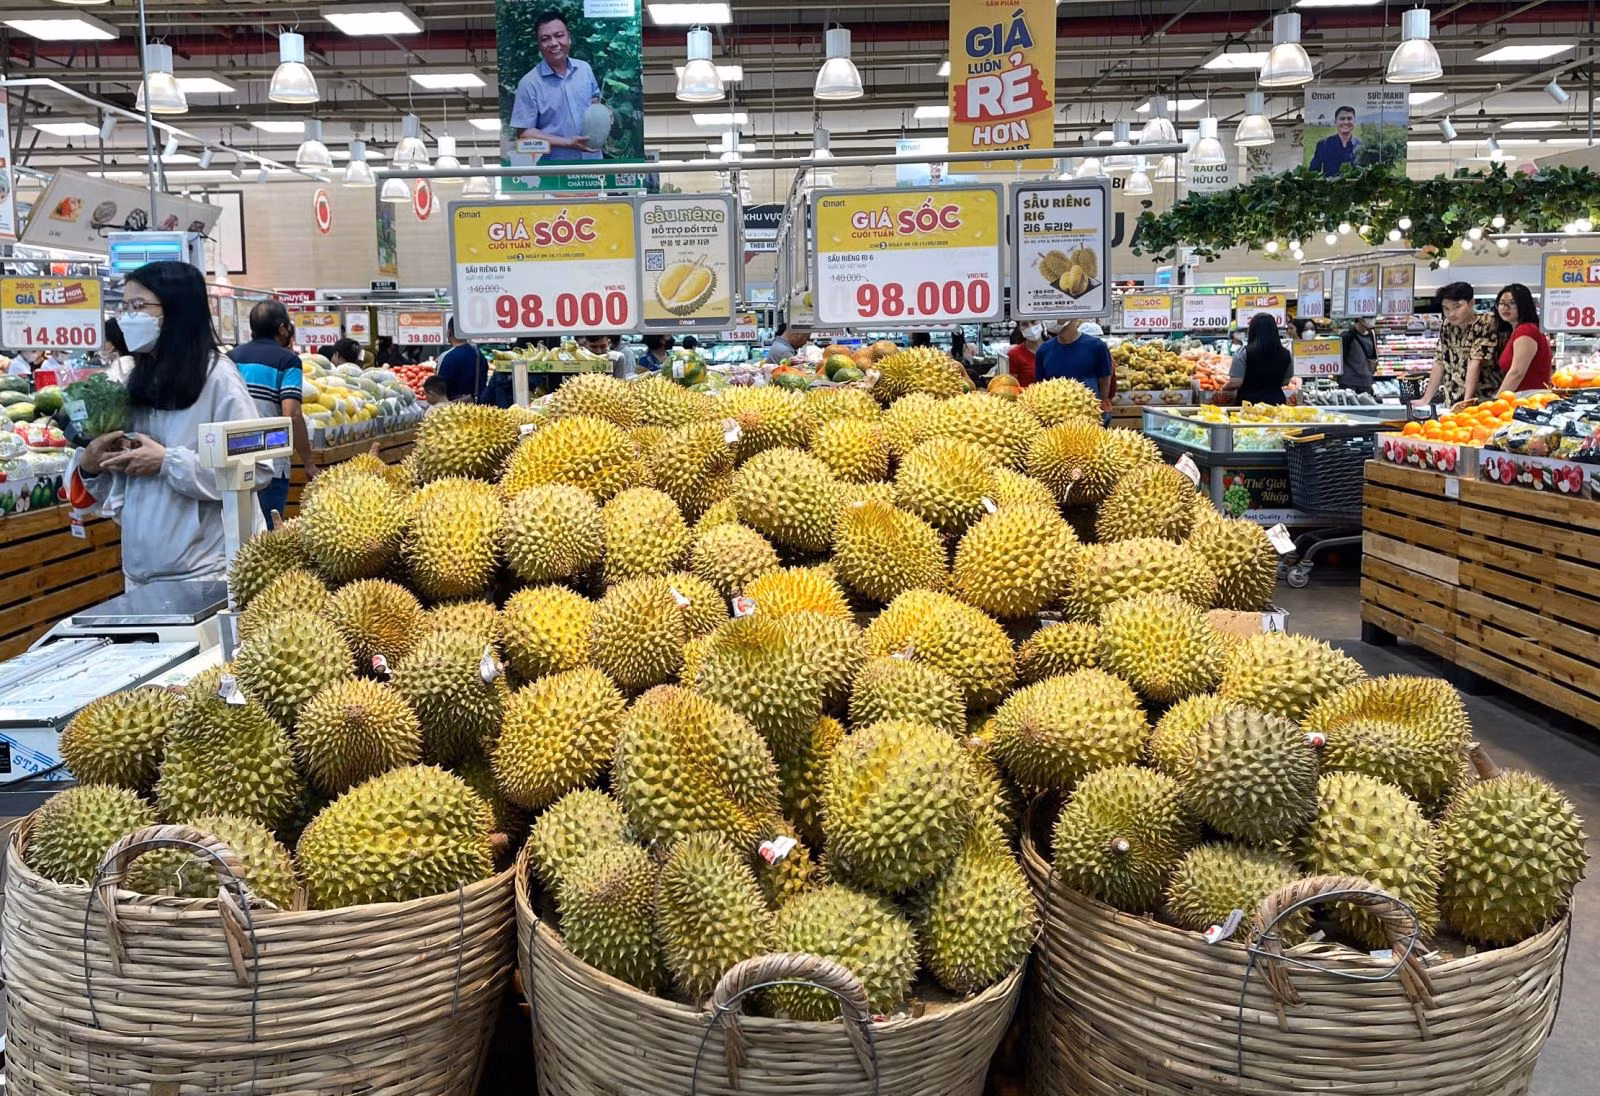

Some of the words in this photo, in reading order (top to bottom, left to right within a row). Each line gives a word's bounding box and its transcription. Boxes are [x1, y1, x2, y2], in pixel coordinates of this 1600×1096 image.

[966, 8, 1033, 58] GIÁ
[968, 59, 1002, 75] LUÔN
[967, 52, 1034, 118] RẺ
[1311, 92, 1335, 100] emart
[972, 119, 1031, 146] HƠN
[823, 200, 846, 208] emart
[1023, 193, 1050, 209] SẦU
[1052, 194, 1091, 208] RIÊNG
[458, 211, 481, 219] emart
[851, 205, 894, 230] GIÁ
[898, 196, 961, 234] SỐC
[488, 217, 532, 241] GIÁ
[534, 208, 597, 247] SỐC
[1044, 222, 1074, 232] 두리안
[869, 254, 874, 262] 6
[507, 265, 512, 273] 6
[1562, 268, 1585, 283] GIÁ
[856, 278, 991, 318] 98.000
[495, 291, 629, 329] 98.000
[1133, 317, 1168, 326] 24.500
[1192, 317, 1228, 326] 25.000
[23, 326, 96, 345] 14.800
[407, 335, 441, 343] 39.800
[728, 331, 756, 339] 15.800
[1310, 363, 1339, 373] 9.900
[1244, 477, 1263, 488] Thế
[1259, 513, 1281, 522] Quality
